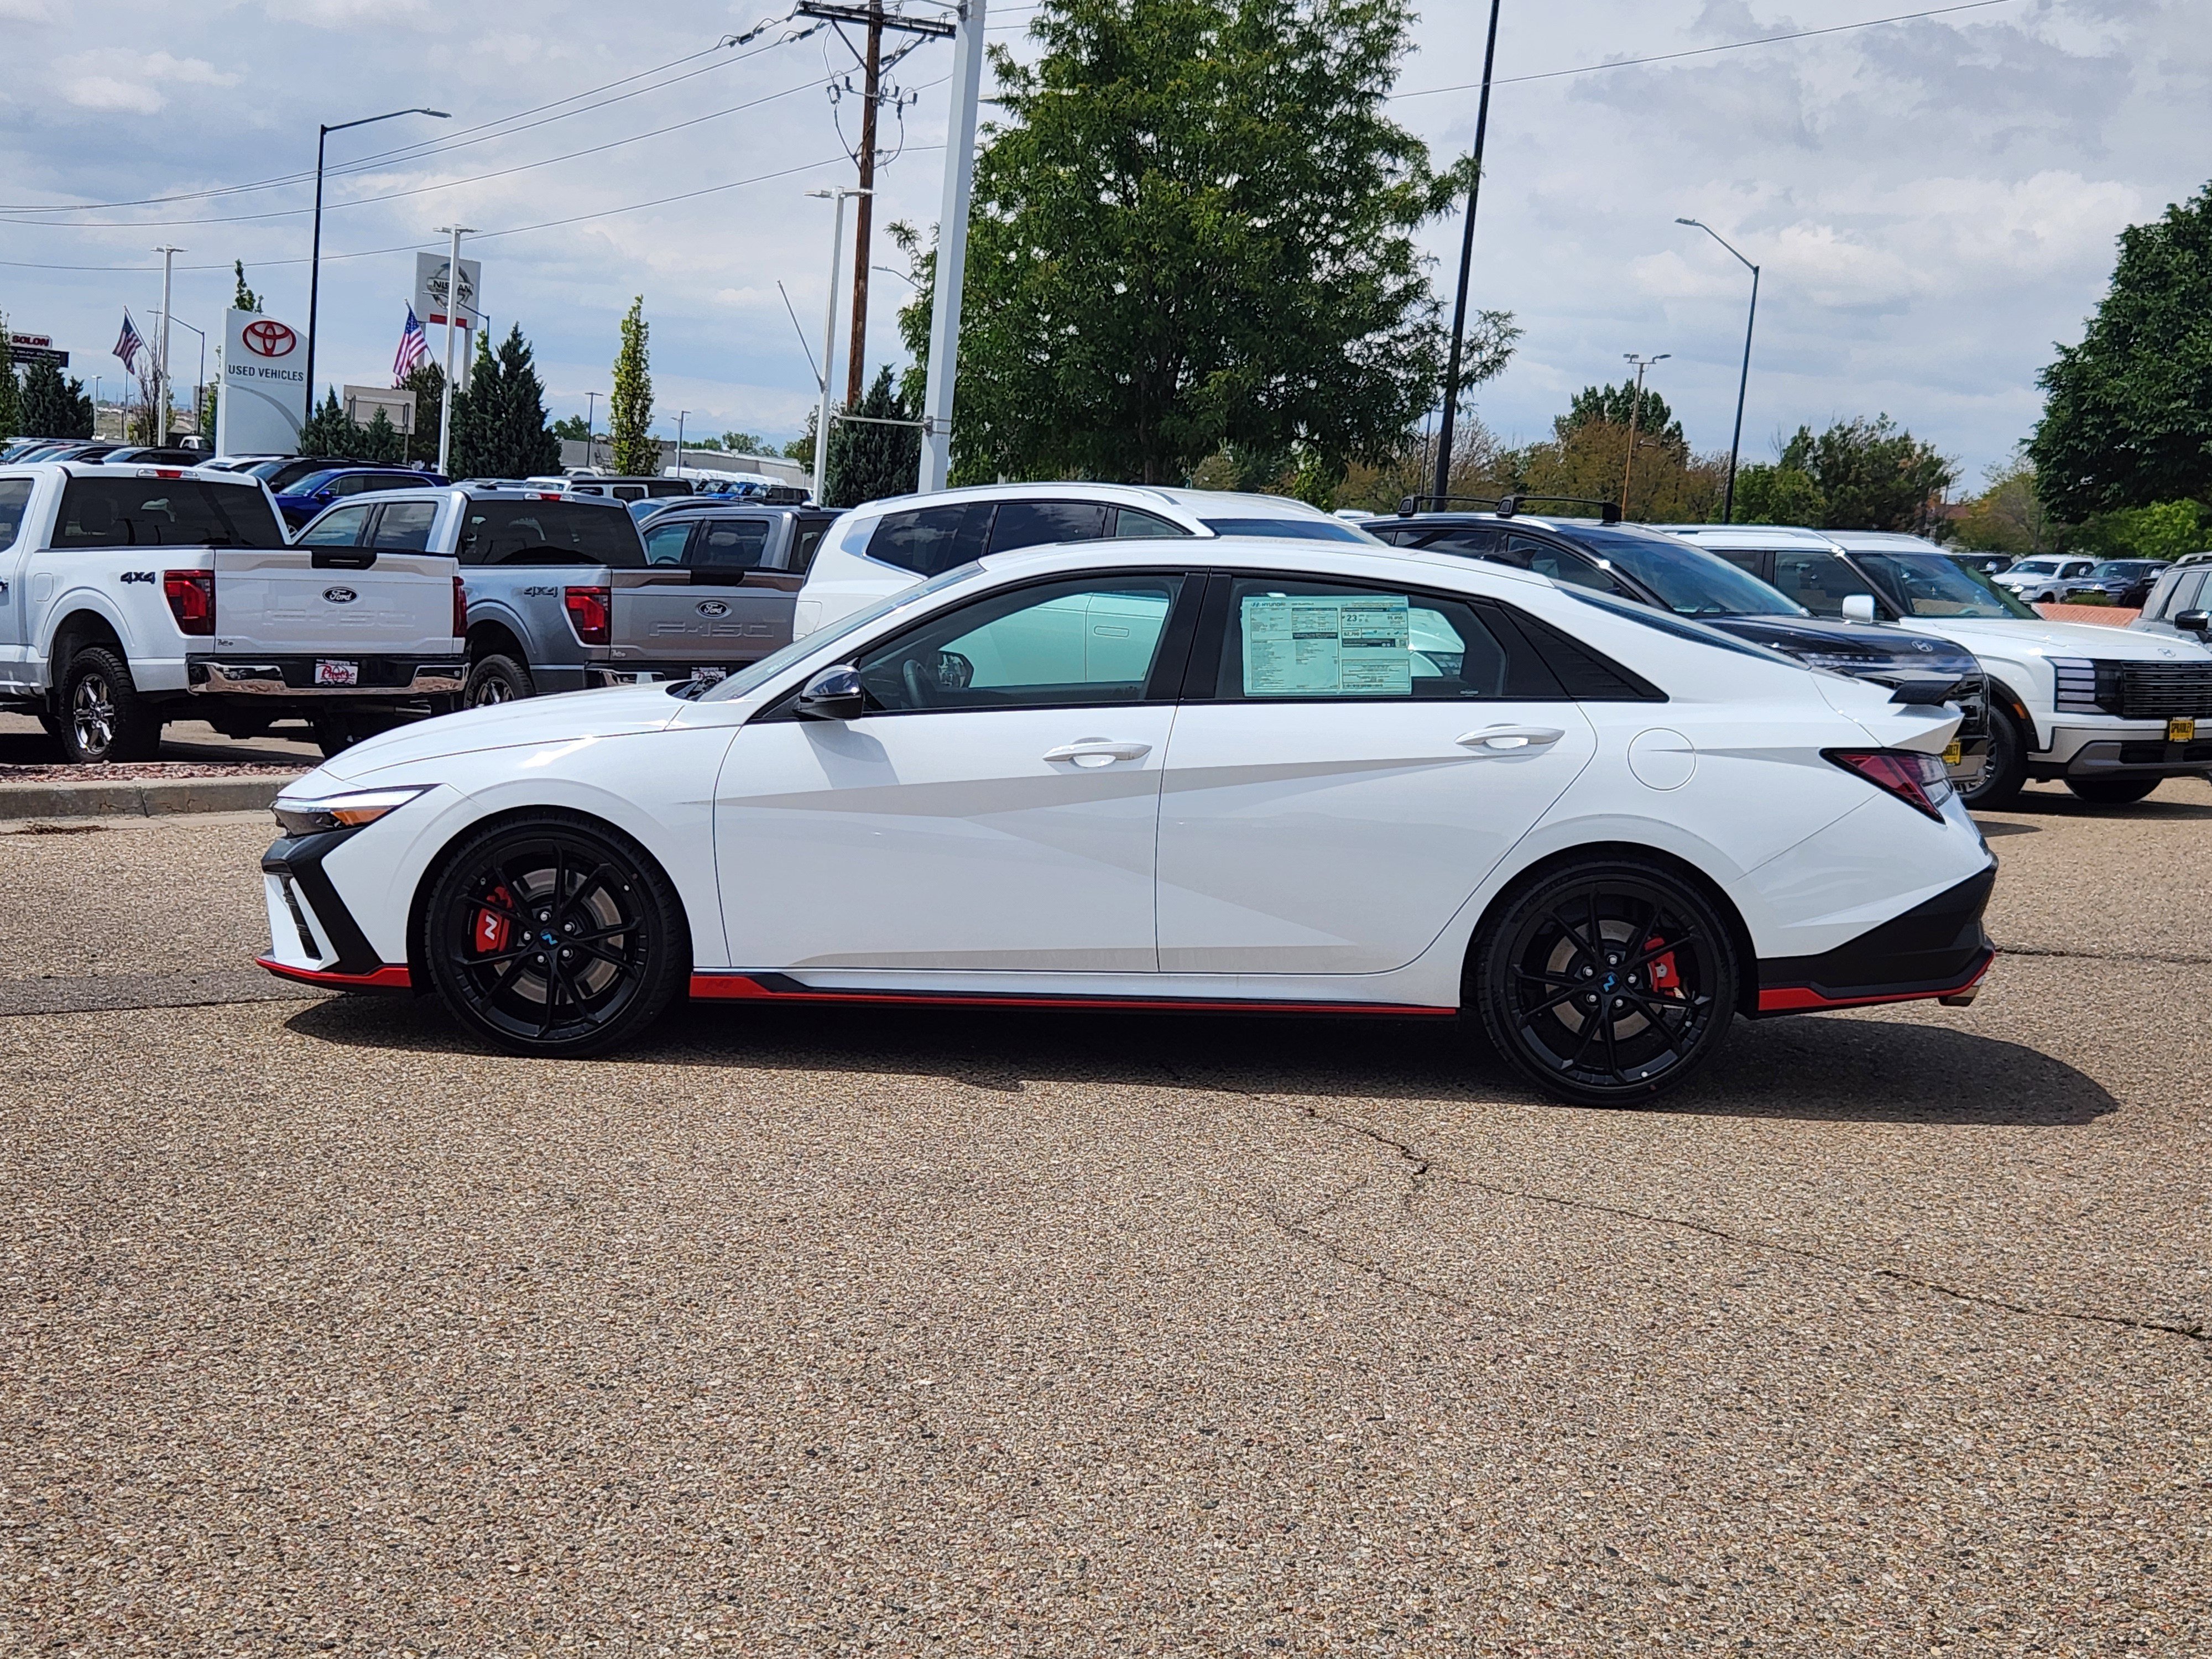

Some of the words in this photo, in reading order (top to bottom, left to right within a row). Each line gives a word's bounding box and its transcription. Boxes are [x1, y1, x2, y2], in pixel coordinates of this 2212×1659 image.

[433, 280, 471, 294] NISAN
[12, 335, 49, 347] SOLON
[228, 364, 255, 377] USED
[258, 368, 304, 382] VEHICLES
[330, 590, 352, 601] Ford
[703, 603, 723, 614] Ford
